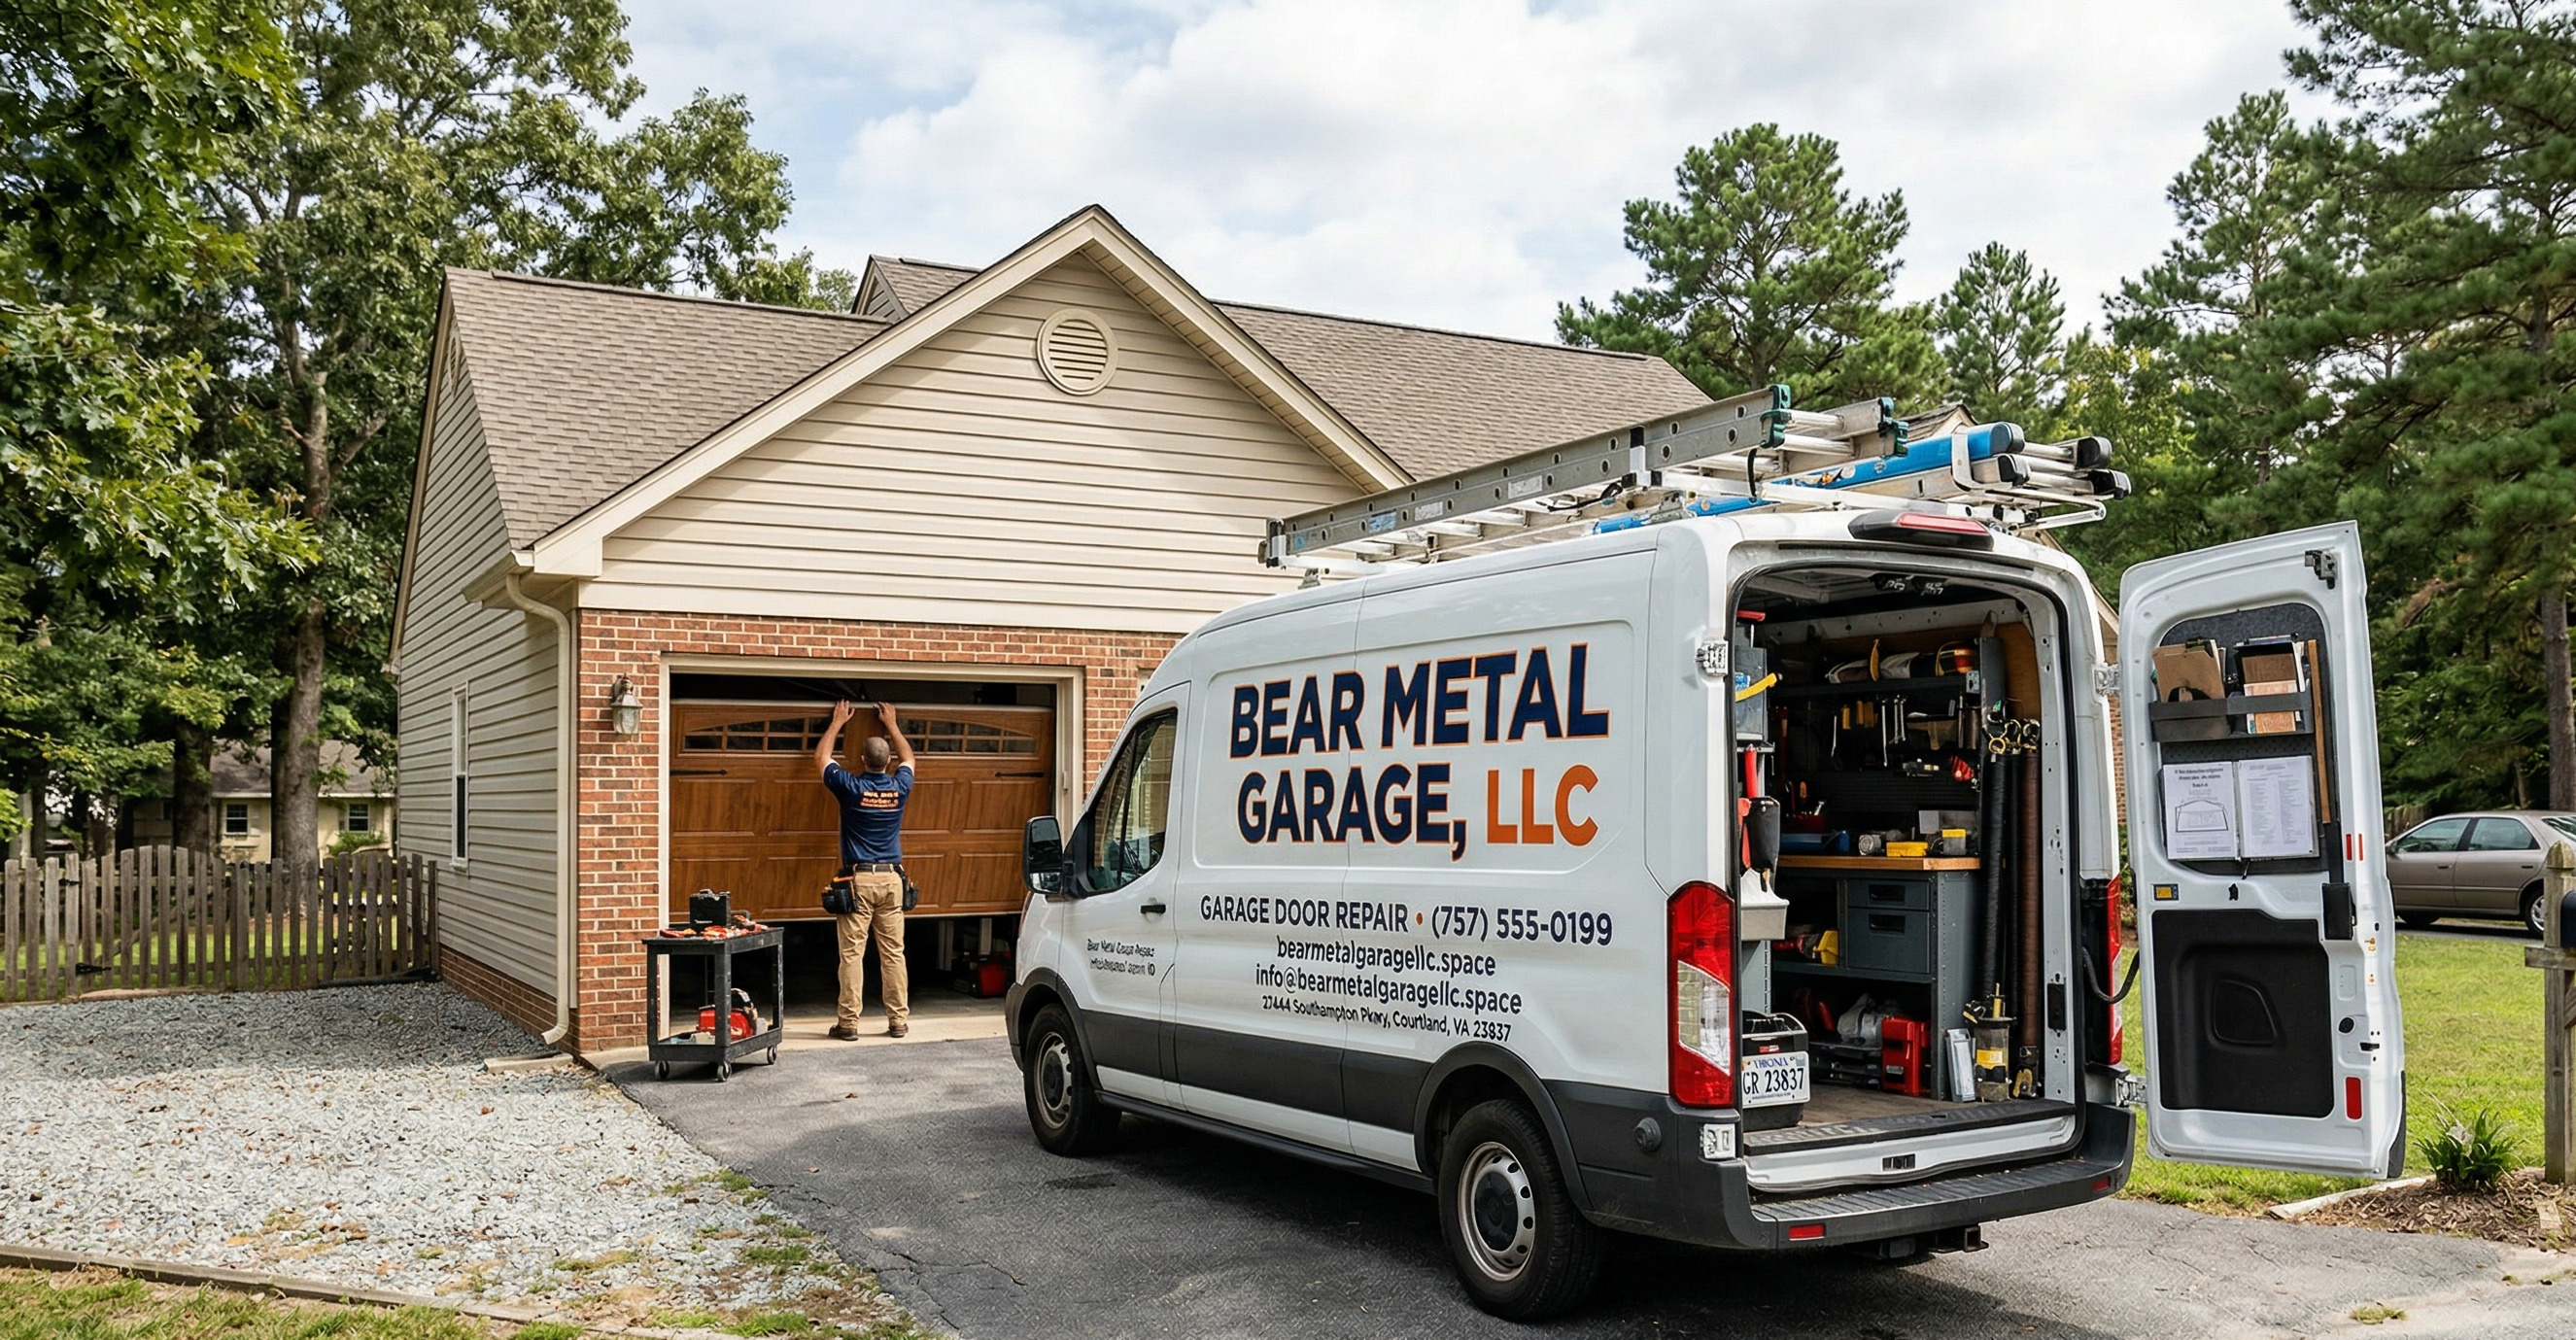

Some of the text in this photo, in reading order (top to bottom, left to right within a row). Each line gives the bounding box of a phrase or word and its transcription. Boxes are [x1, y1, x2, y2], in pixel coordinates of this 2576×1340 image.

[1230, 642, 1610, 759] BEAR METAL
[1238, 763, 1599, 862] GARAGE, LLC
[1200, 895, 1613, 946] GARAGE DOOR REPAIR (757) 555-0199
[1276, 934, 1496, 979] bearmetalgaragellc.space
[1255, 963, 1523, 1015] info@bearmetalgaragellc.space
[1392, 1011, 1451, 1037] Courtland,
[1453, 1017, 1470, 1037] VA
[1473, 1019, 1512, 1043] 23837
[1765, 1067, 1804, 1092] 23837
